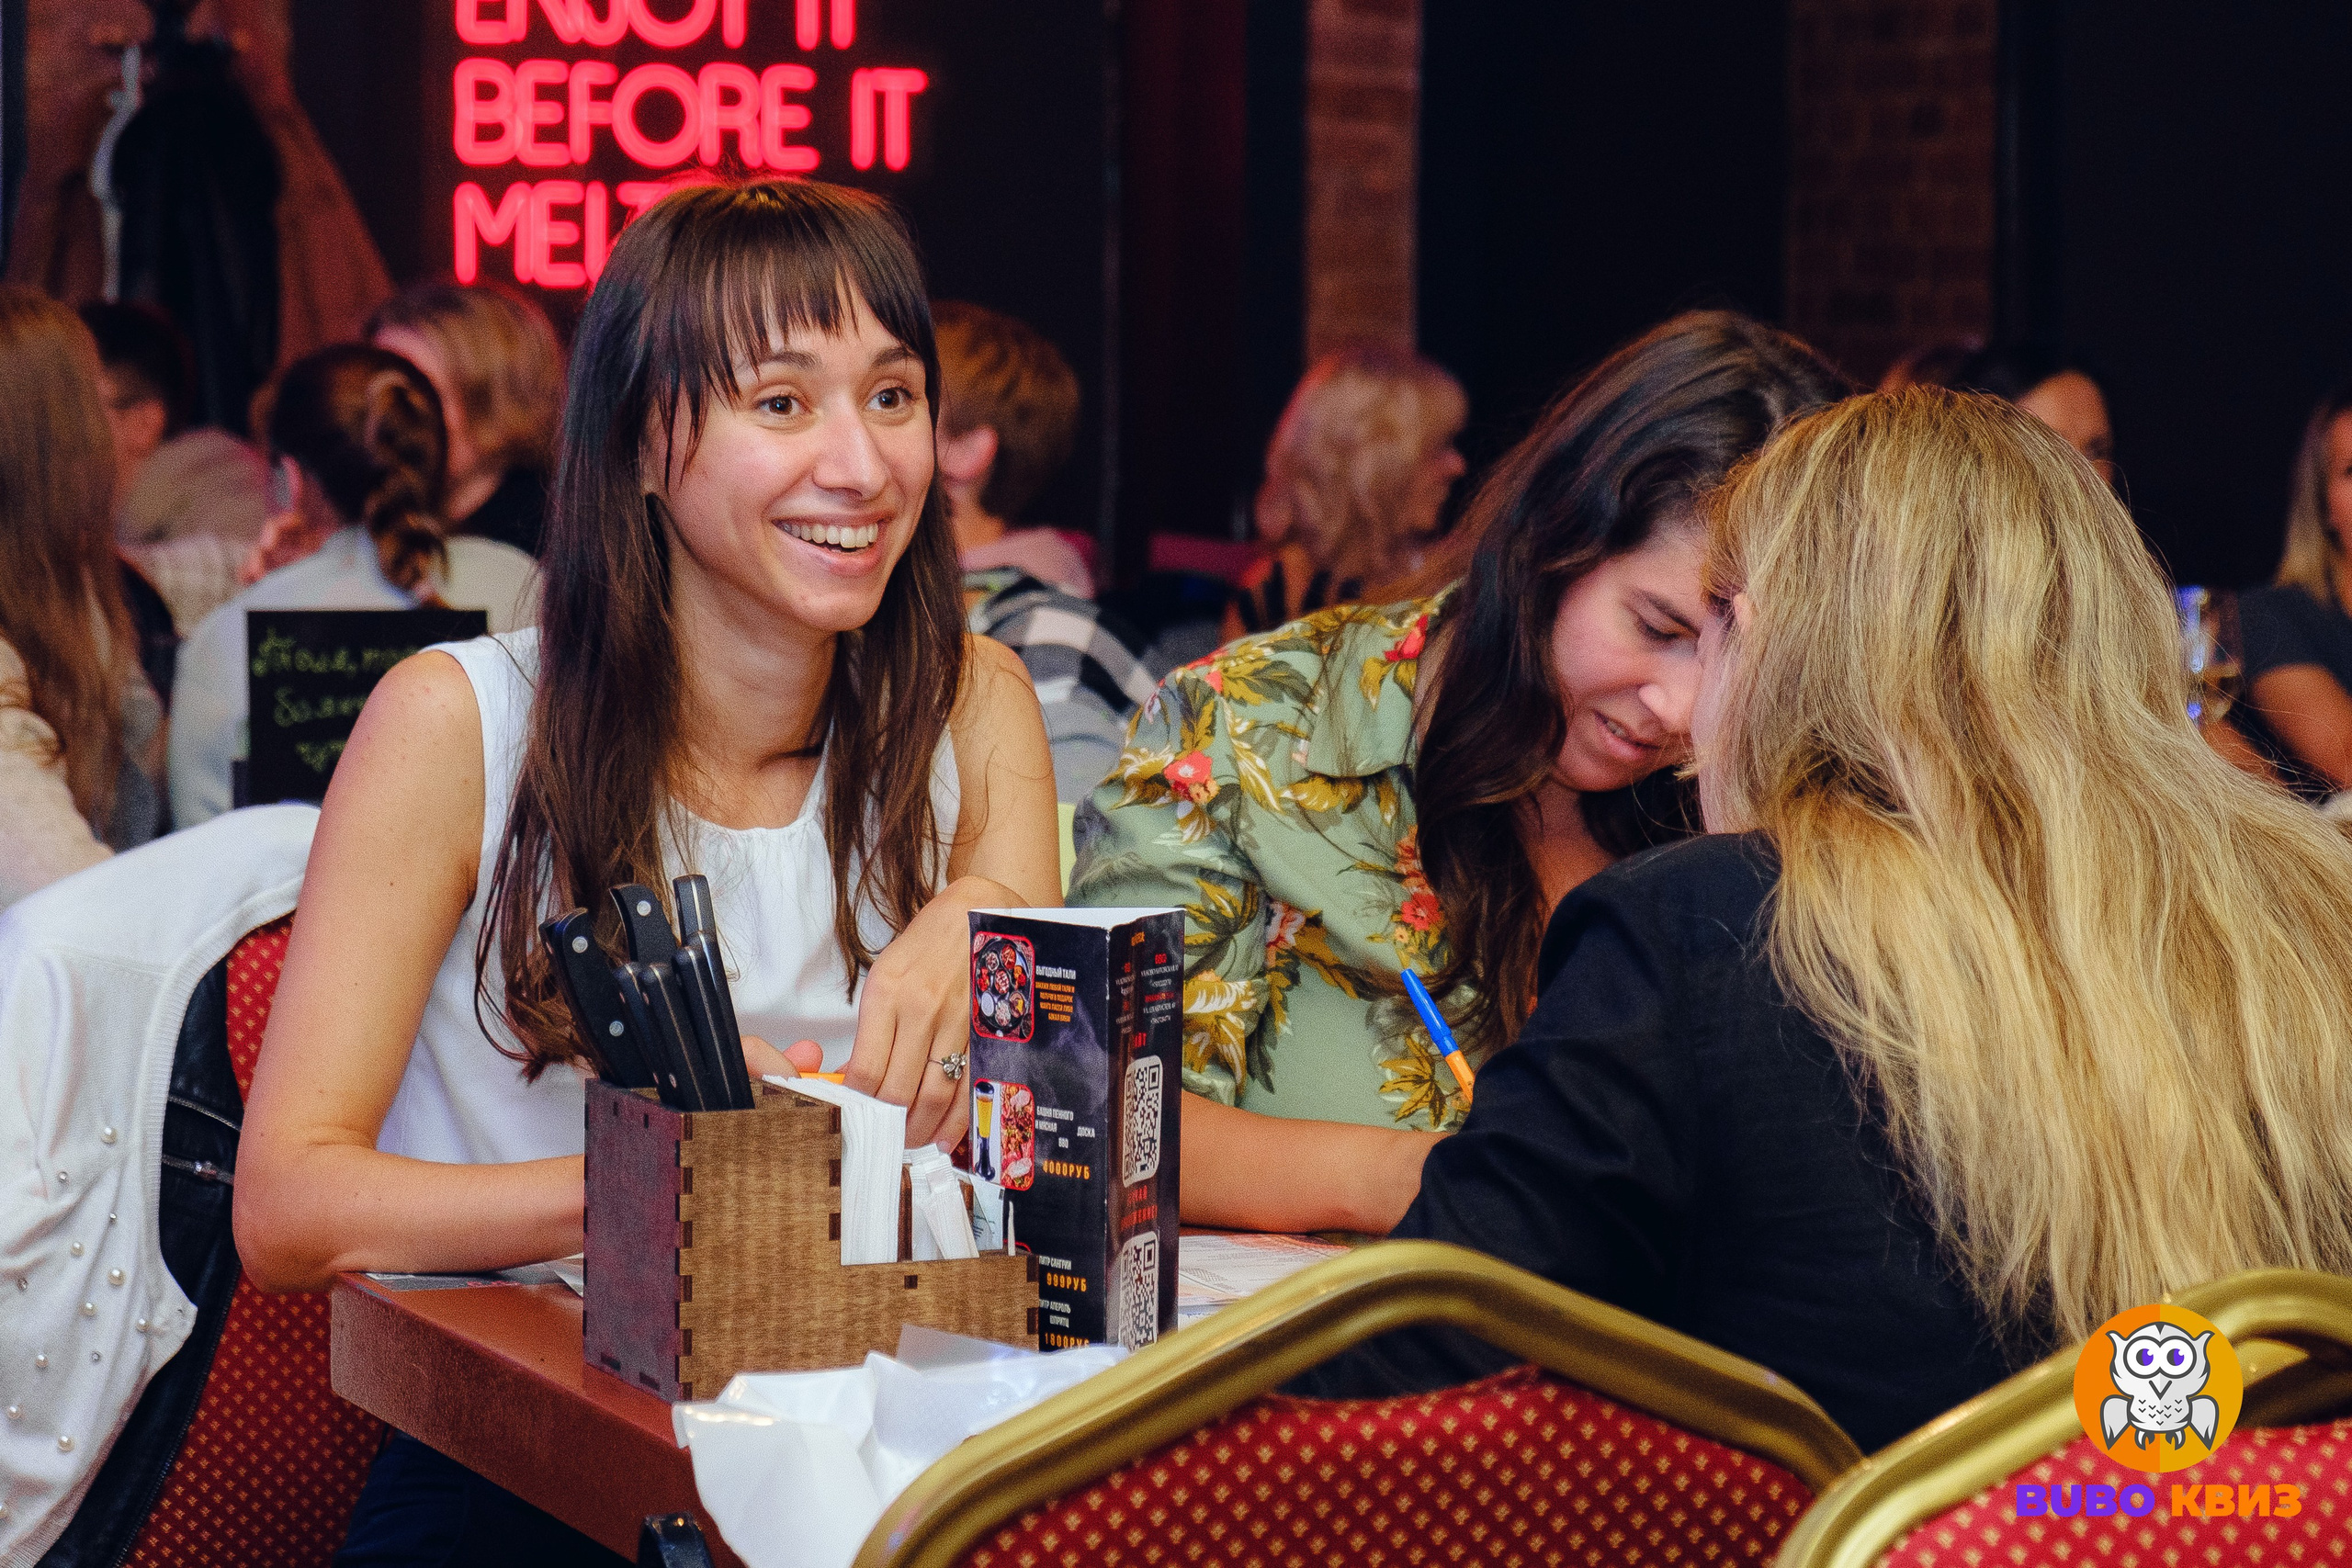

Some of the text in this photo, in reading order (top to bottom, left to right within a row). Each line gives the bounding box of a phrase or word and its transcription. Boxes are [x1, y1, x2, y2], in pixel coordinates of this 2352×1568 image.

[454, 58, 928, 171] BEFORE IT
[454, 181, 675, 289] MEL
[1046, 1272, 1087, 1292] 999РУБ
